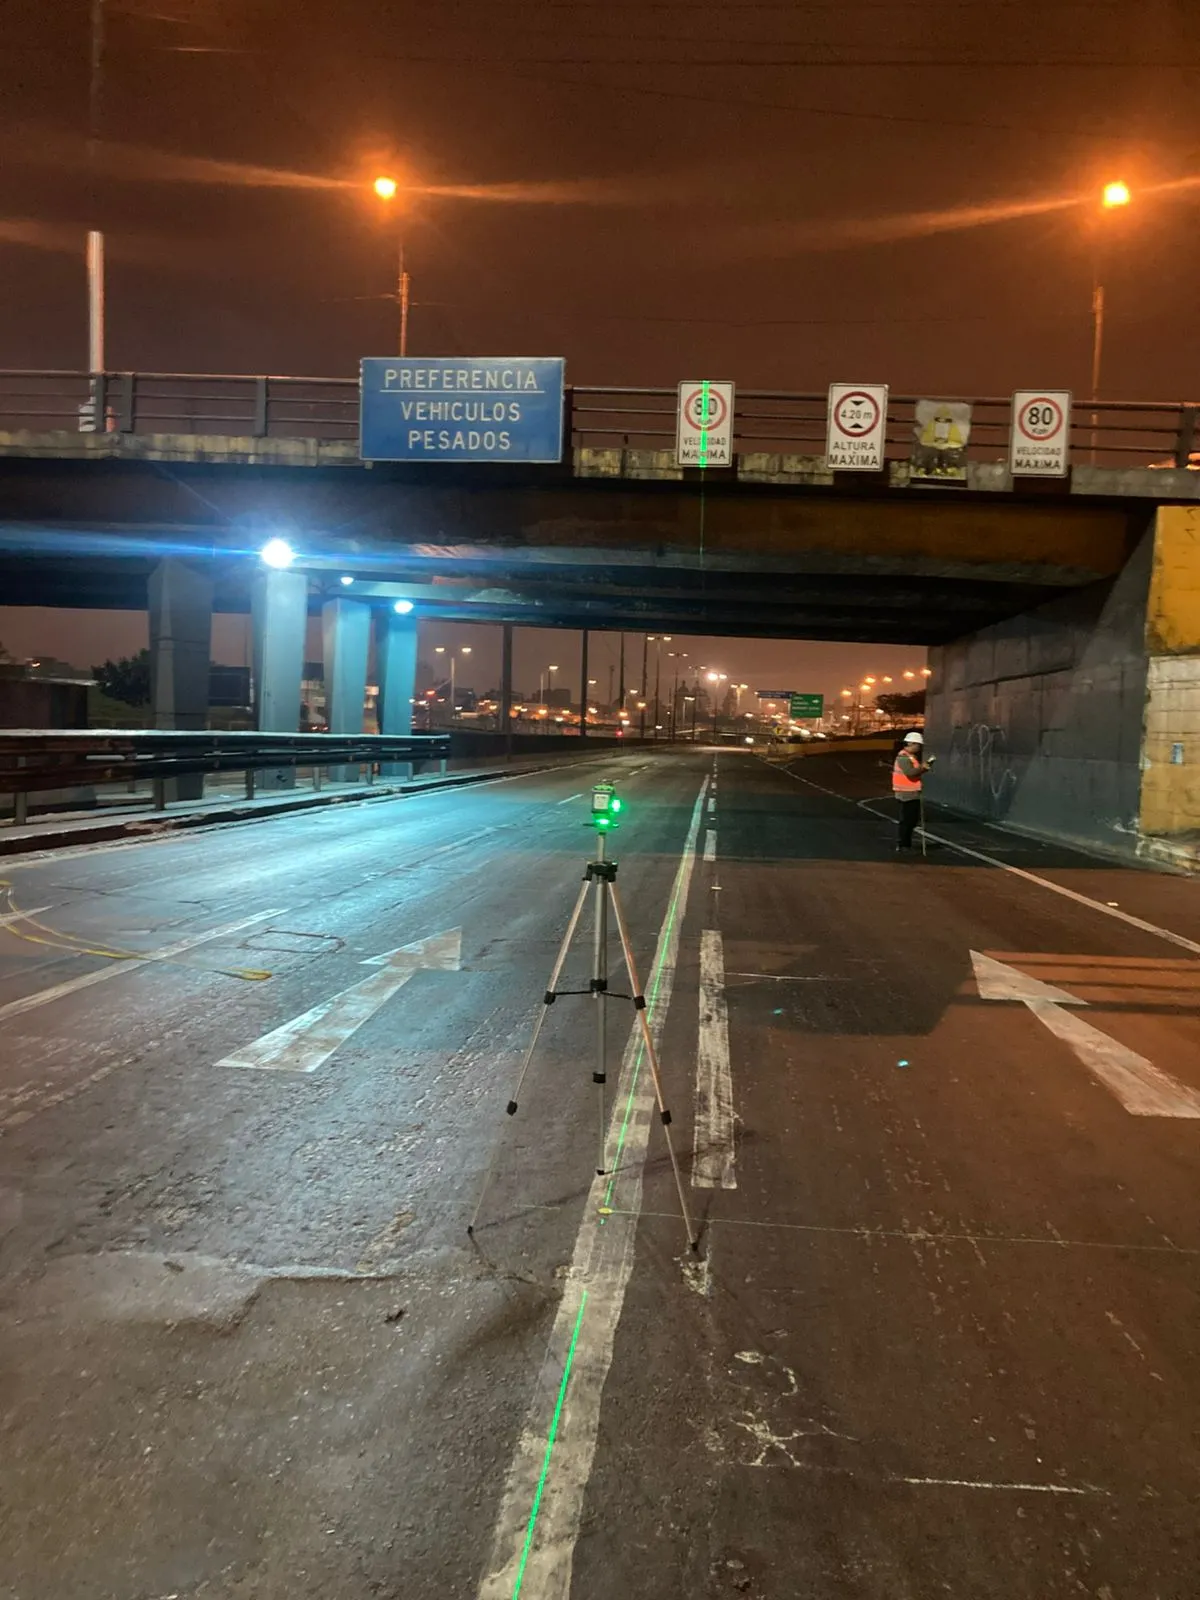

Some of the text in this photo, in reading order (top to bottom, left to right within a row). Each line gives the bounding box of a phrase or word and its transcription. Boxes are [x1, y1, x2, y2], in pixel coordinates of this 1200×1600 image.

[384, 368, 538, 390] PREFERENCIA
[401, 401, 521, 422] VEHICULOS
[1028, 407, 1053, 425] 80
[408, 430, 511, 450] PESADOS
[682, 437, 727, 446] VELIDAD
[833, 441, 876, 451] ALTURA
[681, 449, 726, 459] MAIMA
[829, 454, 879, 466] MAXIMA
[1014, 459, 1061, 469] MAXIMA
